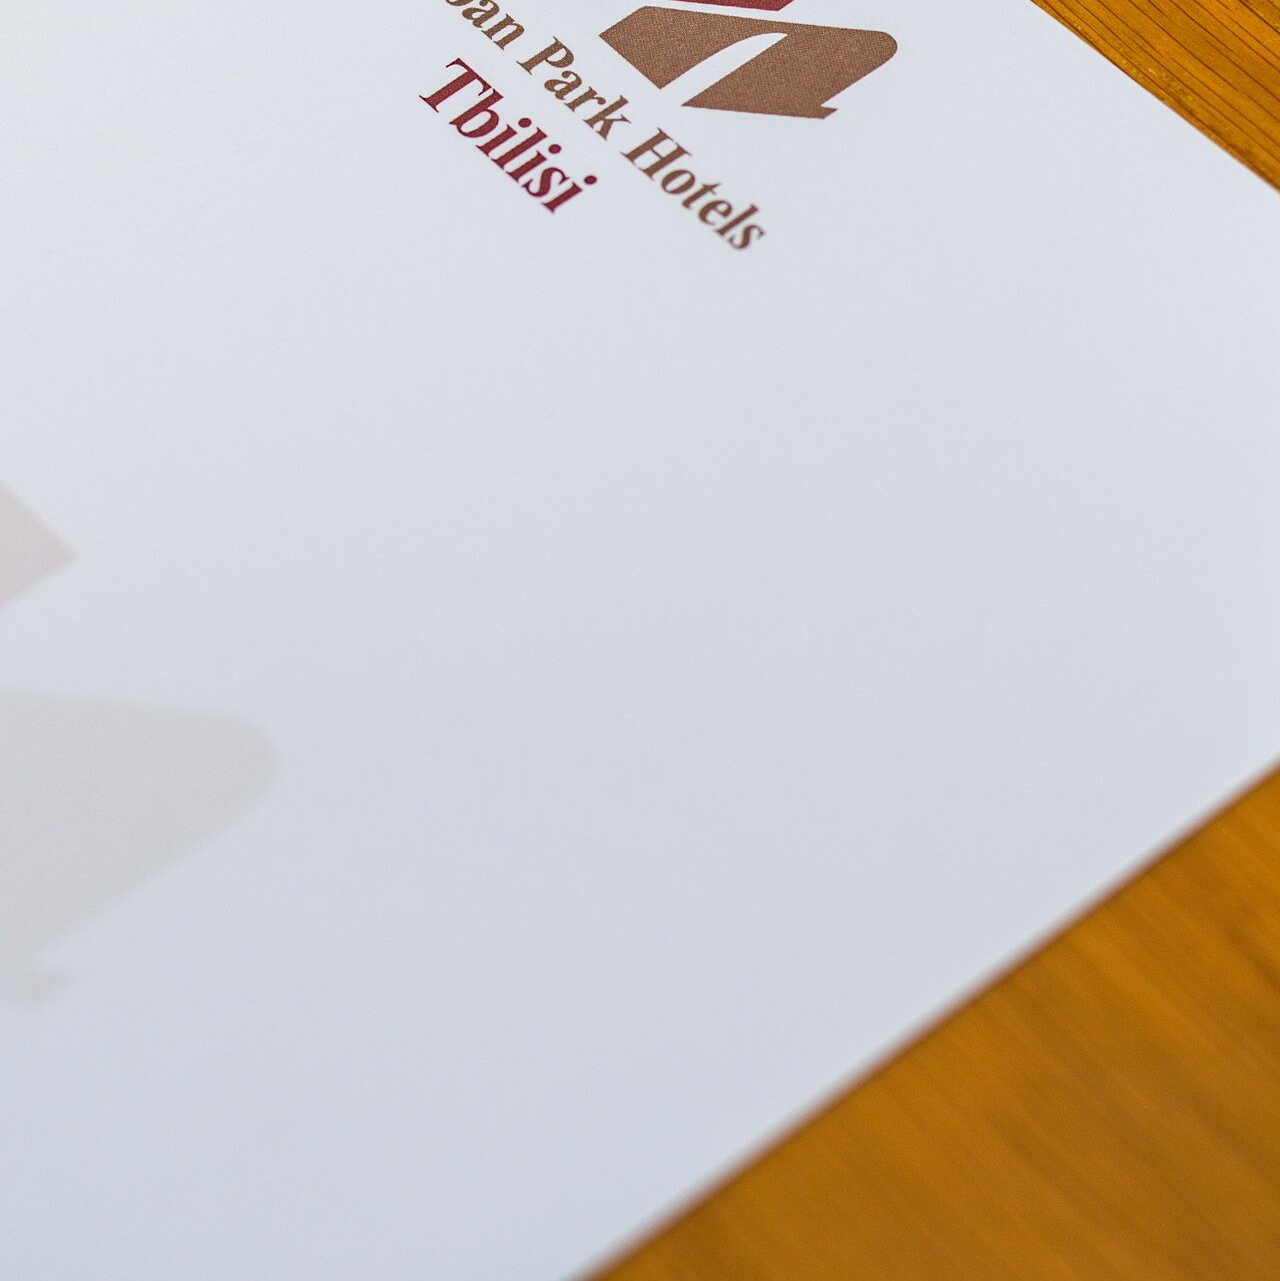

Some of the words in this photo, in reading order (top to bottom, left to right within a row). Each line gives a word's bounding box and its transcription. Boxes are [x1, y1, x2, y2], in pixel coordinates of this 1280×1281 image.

[419, 57, 598, 214] Tbilisi
[516, 35, 631, 141] Park
[619, 127, 766, 251] Hotels
